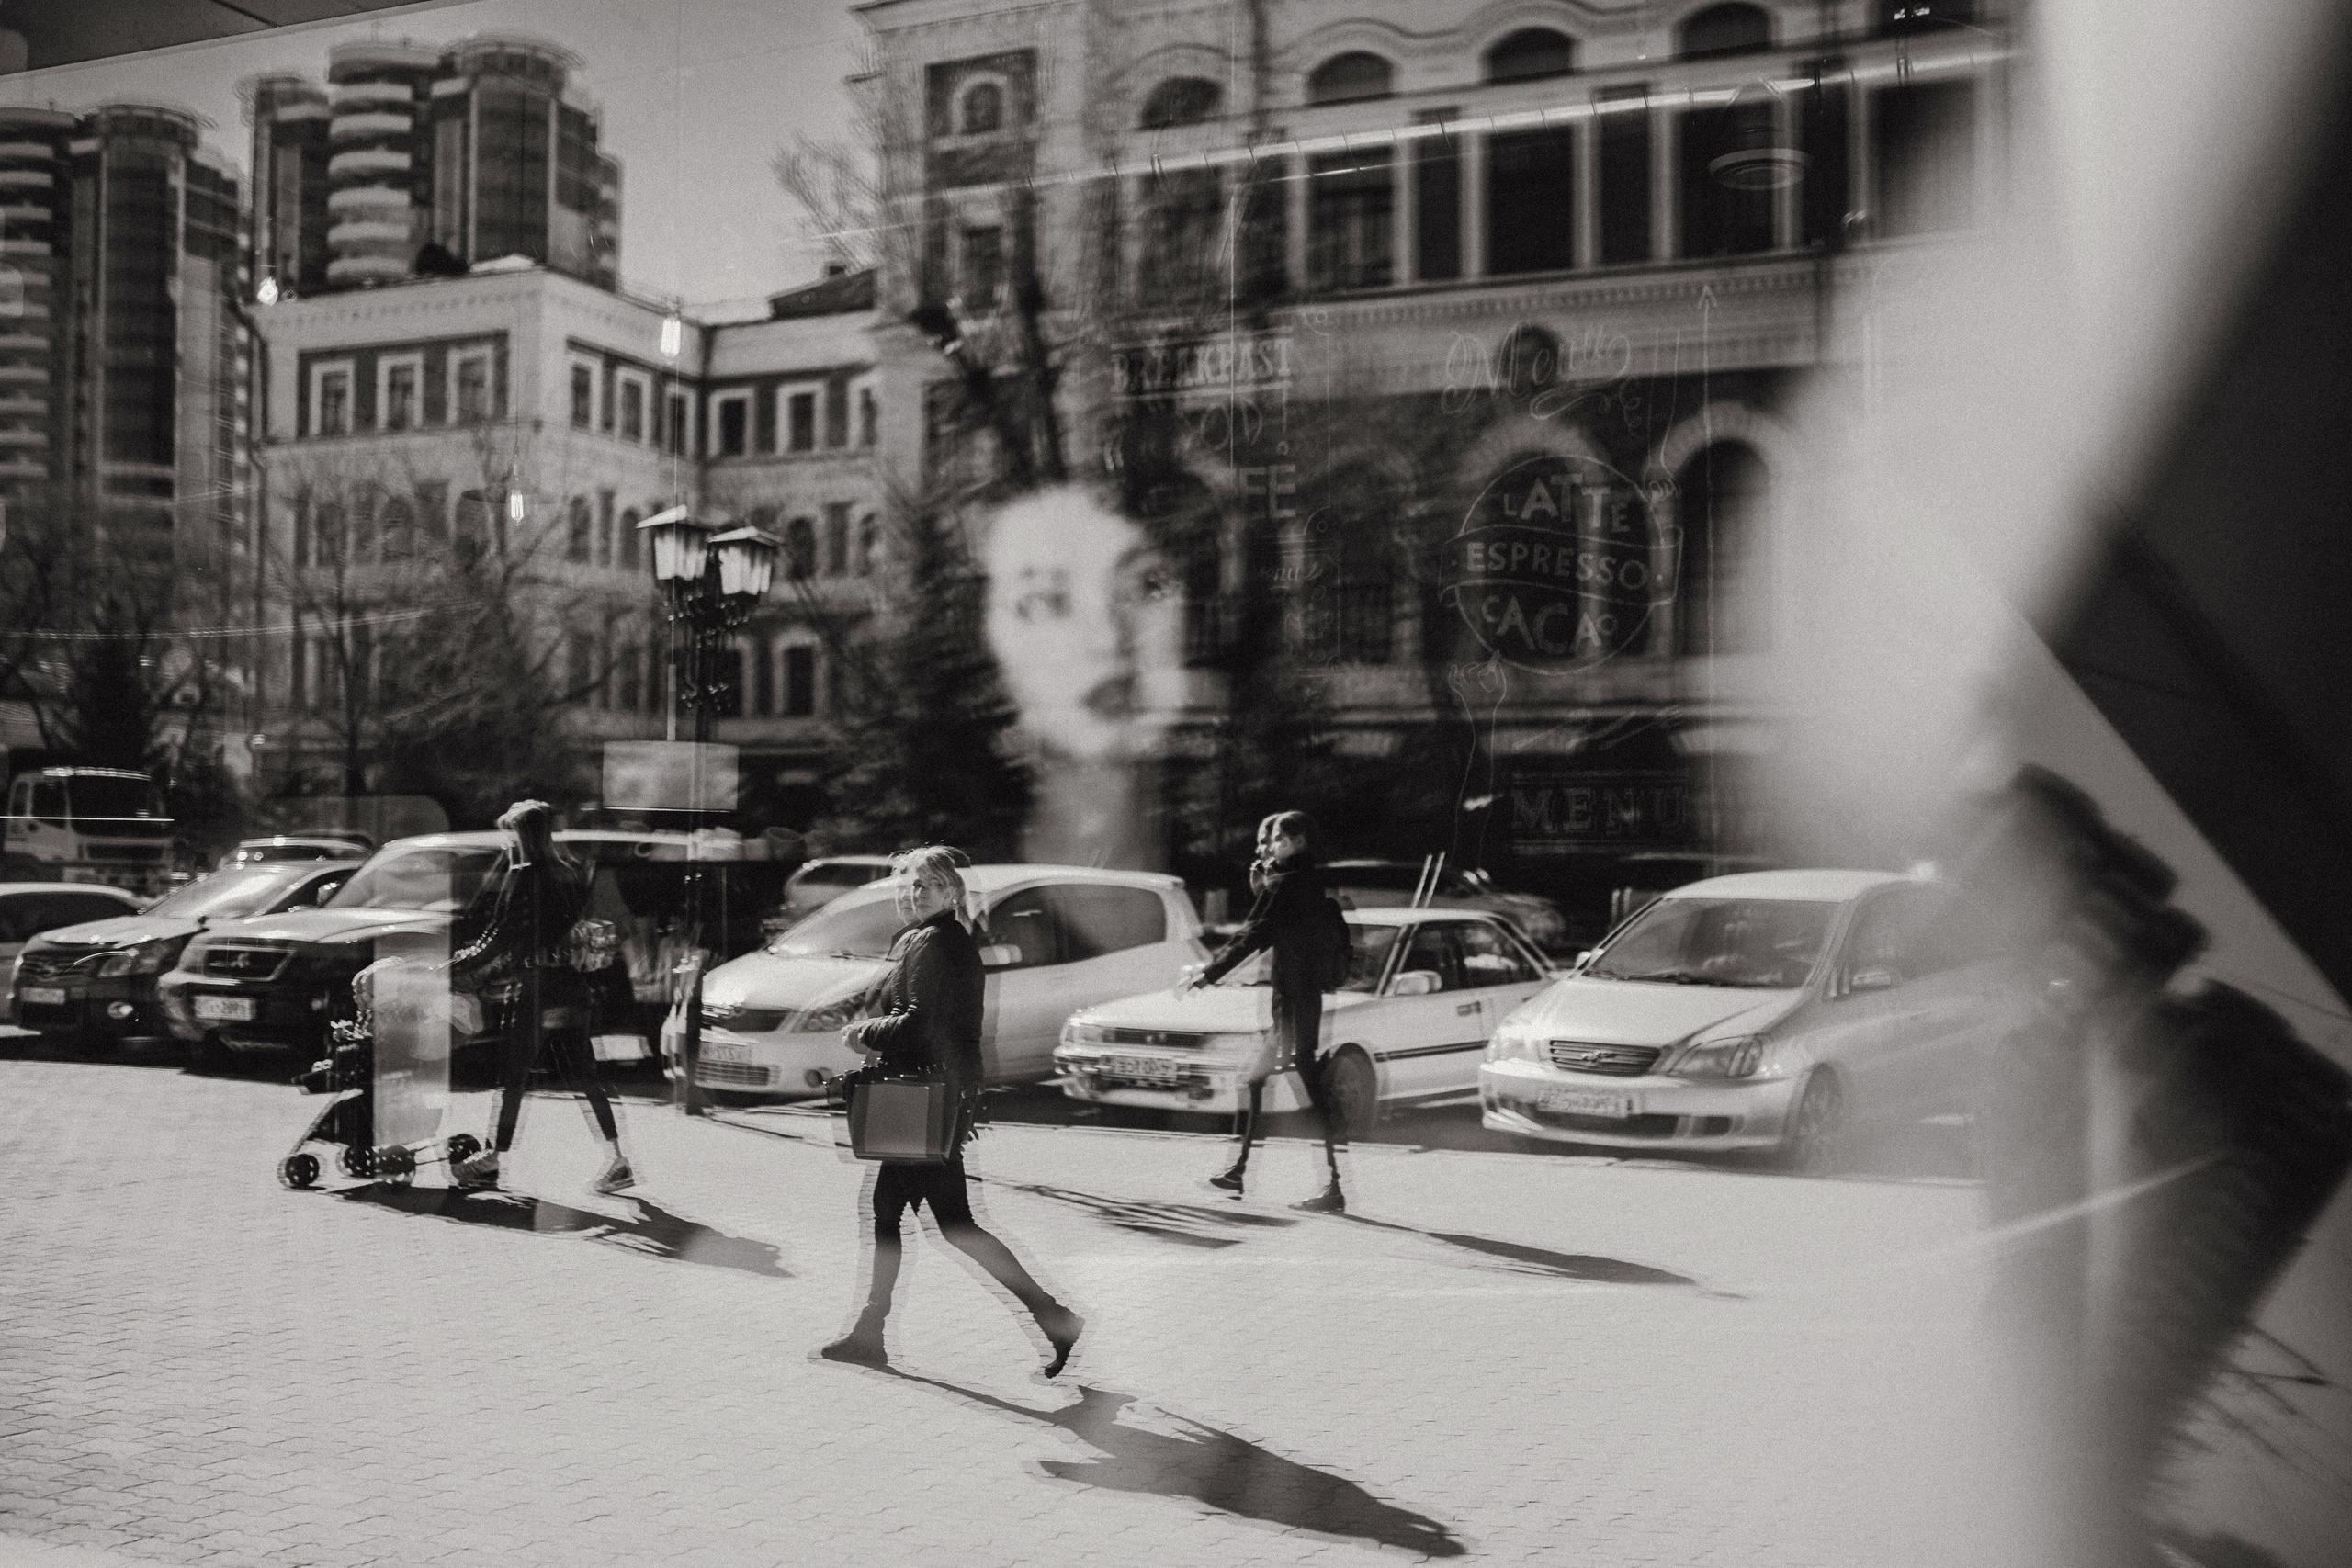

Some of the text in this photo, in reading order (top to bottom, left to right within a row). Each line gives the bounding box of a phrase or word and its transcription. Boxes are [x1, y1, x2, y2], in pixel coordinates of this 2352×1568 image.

[1502, 472, 1632, 535] LATTE
[1465, 539, 1650, 591] ESPRESSO
[1480, 594, 1619, 657] CACAO
[1510, 785, 1689, 836] MENU
